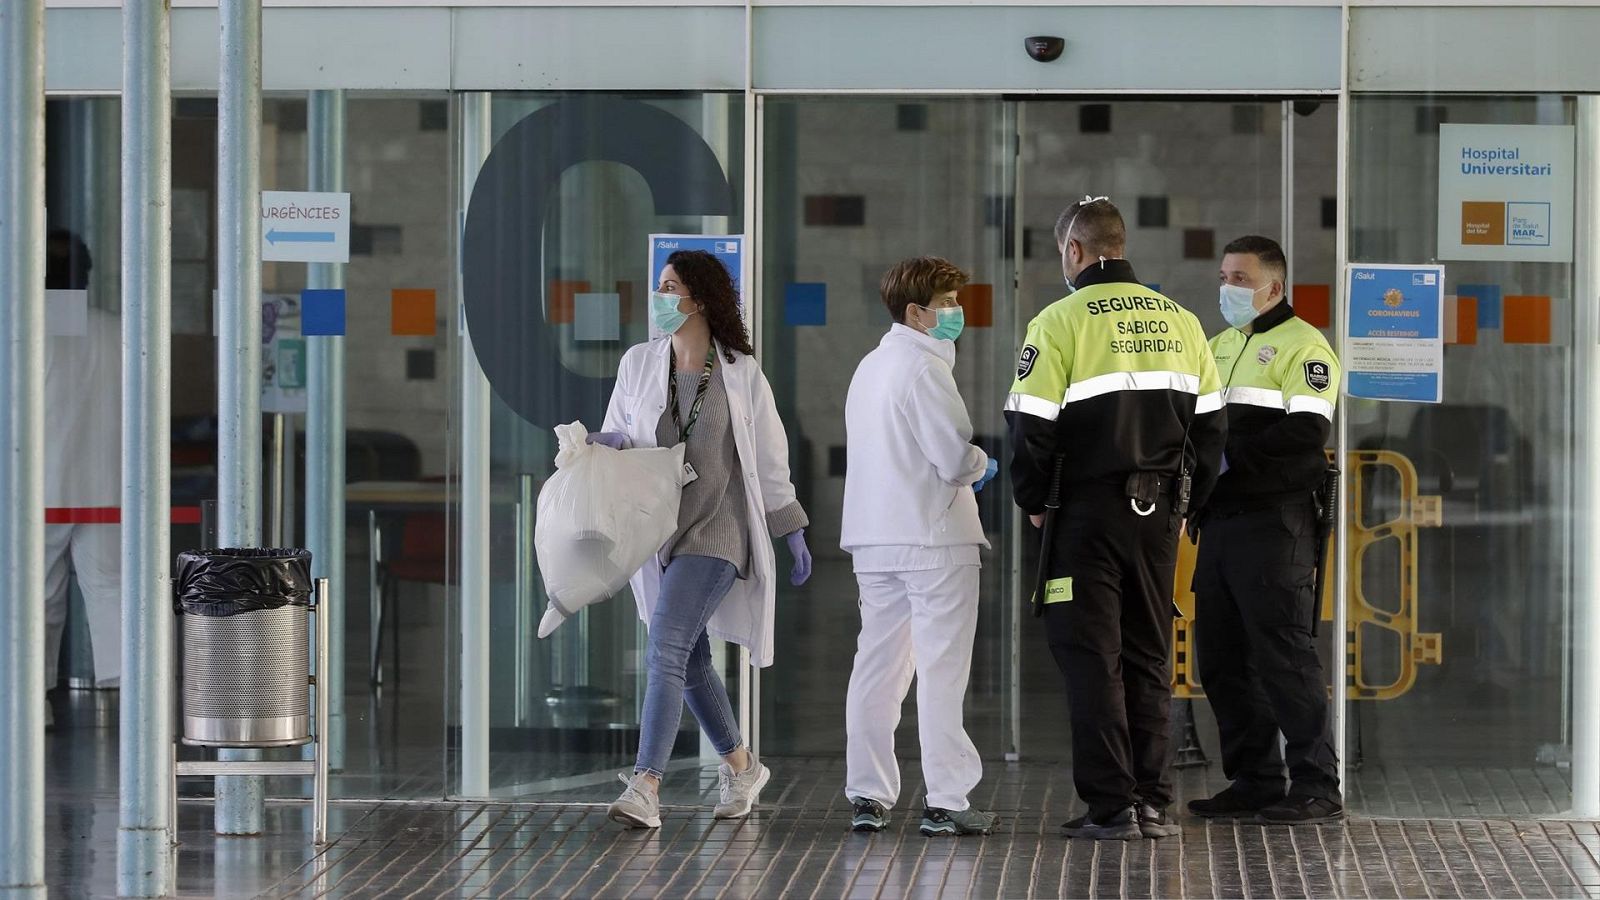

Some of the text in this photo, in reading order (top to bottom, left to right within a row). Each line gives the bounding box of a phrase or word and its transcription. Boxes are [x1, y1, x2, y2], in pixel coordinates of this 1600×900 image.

[1461, 147, 1519, 162] Hospital
[1461, 162, 1551, 176] Universitari
[261, 202, 341, 220] URGÈNCIES
[1465, 222, 1490, 230] Hospital
[1512, 229, 1535, 237] MAR
[1086, 296, 1180, 317] SEGURETAT
[1367, 309, 1420, 318] CORONAVIRUS
[1116, 320, 1169, 335] SABICO
[1110, 339, 1184, 355] SEGURIDAD
